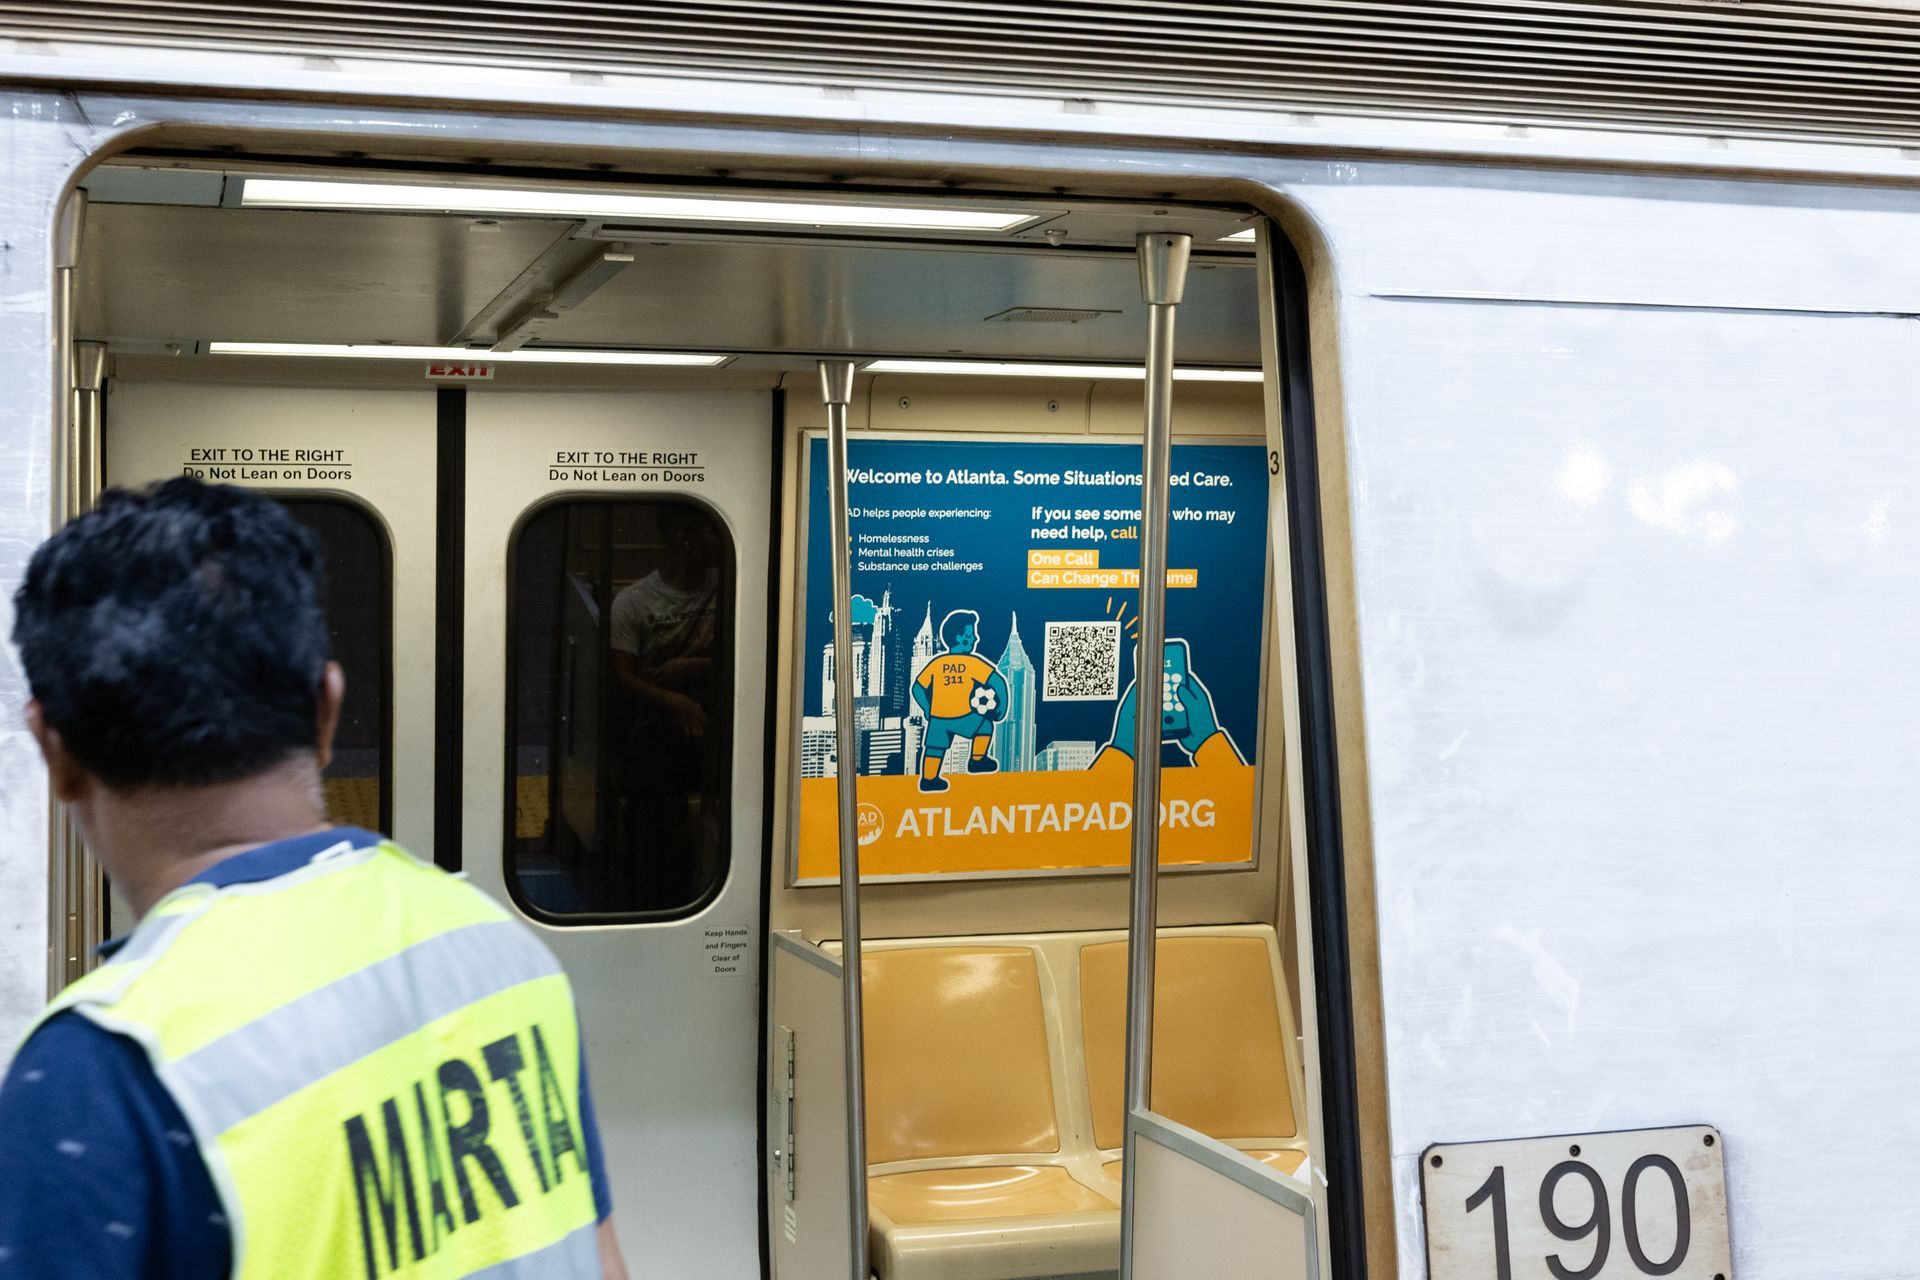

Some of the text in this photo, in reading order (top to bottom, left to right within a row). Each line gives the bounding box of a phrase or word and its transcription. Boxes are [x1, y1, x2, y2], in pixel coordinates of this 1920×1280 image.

[191, 449, 344, 462] EXIT TO THE RIGHT
[556, 452, 698, 465] EXIT TO THE RIGHT
[1270, 451, 1280, 475] 3
[183, 467, 352, 480] Do Not Lean on Doors
[549, 469, 705, 482] Do Not Lean on Doors
[847, 468, 922, 484] Welcome
[925, 469, 943, 484] to
[946, 468, 1009, 485] Atlanta.
[1013, 470, 1060, 486] Some
[1063, 470, 1143, 487] Situations
[1193, 472, 1233, 487] Care.
[848, 508, 992, 520] AD helps people experiencing:
[1031, 506, 1043, 520] If
[1044, 508, 1071, 524] you
[1074, 508, 1100, 521] see
[1172, 507, 1203, 521] who
[1205, 509, 1236, 524] may
[858, 533, 930, 544] Homelessness
[1031, 525, 1138, 542] need help, call
[858, 547, 955, 557] Mental health crises
[1031, 552, 1094, 566] One Call
[858, 560, 984, 573] Substance use challenges
[1031, 571, 1060, 585] Can
[1062, 571, 1119, 588] Change
[1121, 571, 1140, 585] Th
[943, 663, 967, 673] PAD
[944, 675, 963, 686] 311
[858, 811, 878, 825] AD
[705, 930, 723, 938] Keep
[705, 942, 747, 950] and Fingers
[1465, 1154, 1691, 1280] 190
